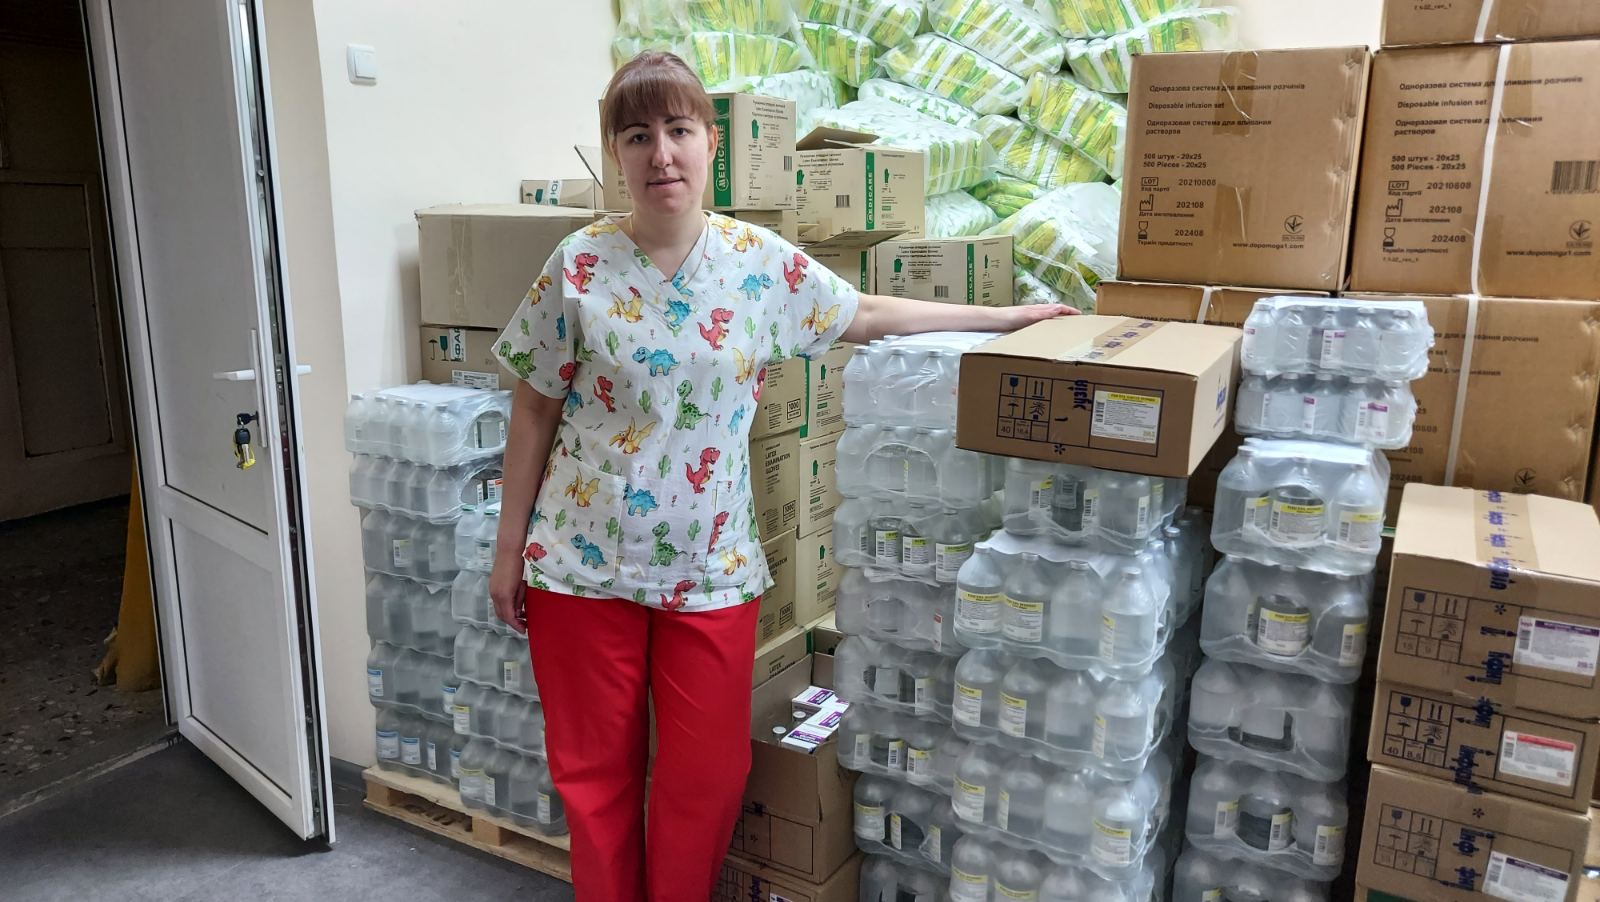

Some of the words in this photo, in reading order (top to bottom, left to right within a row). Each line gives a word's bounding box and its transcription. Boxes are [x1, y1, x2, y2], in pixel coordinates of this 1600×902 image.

[1150, 85, 1190, 93] Одноразова
[1192, 84, 1220, 92] система
[1399, 82, 1447, 91] Одноразова
[1449, 80, 1482, 89] система
[1148, 102, 1184, 110] Disposable
[1398, 99, 1439, 108] Disposable
[1441, 98, 1473, 107] infusion
[1475, 97, 1488, 105] set
[1449, 117, 1483, 125] система
[716, 124, 728, 189] MEDICARE
[1392, 154, 1406, 162] 500
[1391, 163, 1405, 171] 500
[1427, 181, 1472, 190] 20210808
[1176, 201, 1204, 209] 202108
[1429, 205, 1462, 214] 202108
[1174, 229, 1204, 237] 202408
[1431, 234, 1466, 243] 202408
